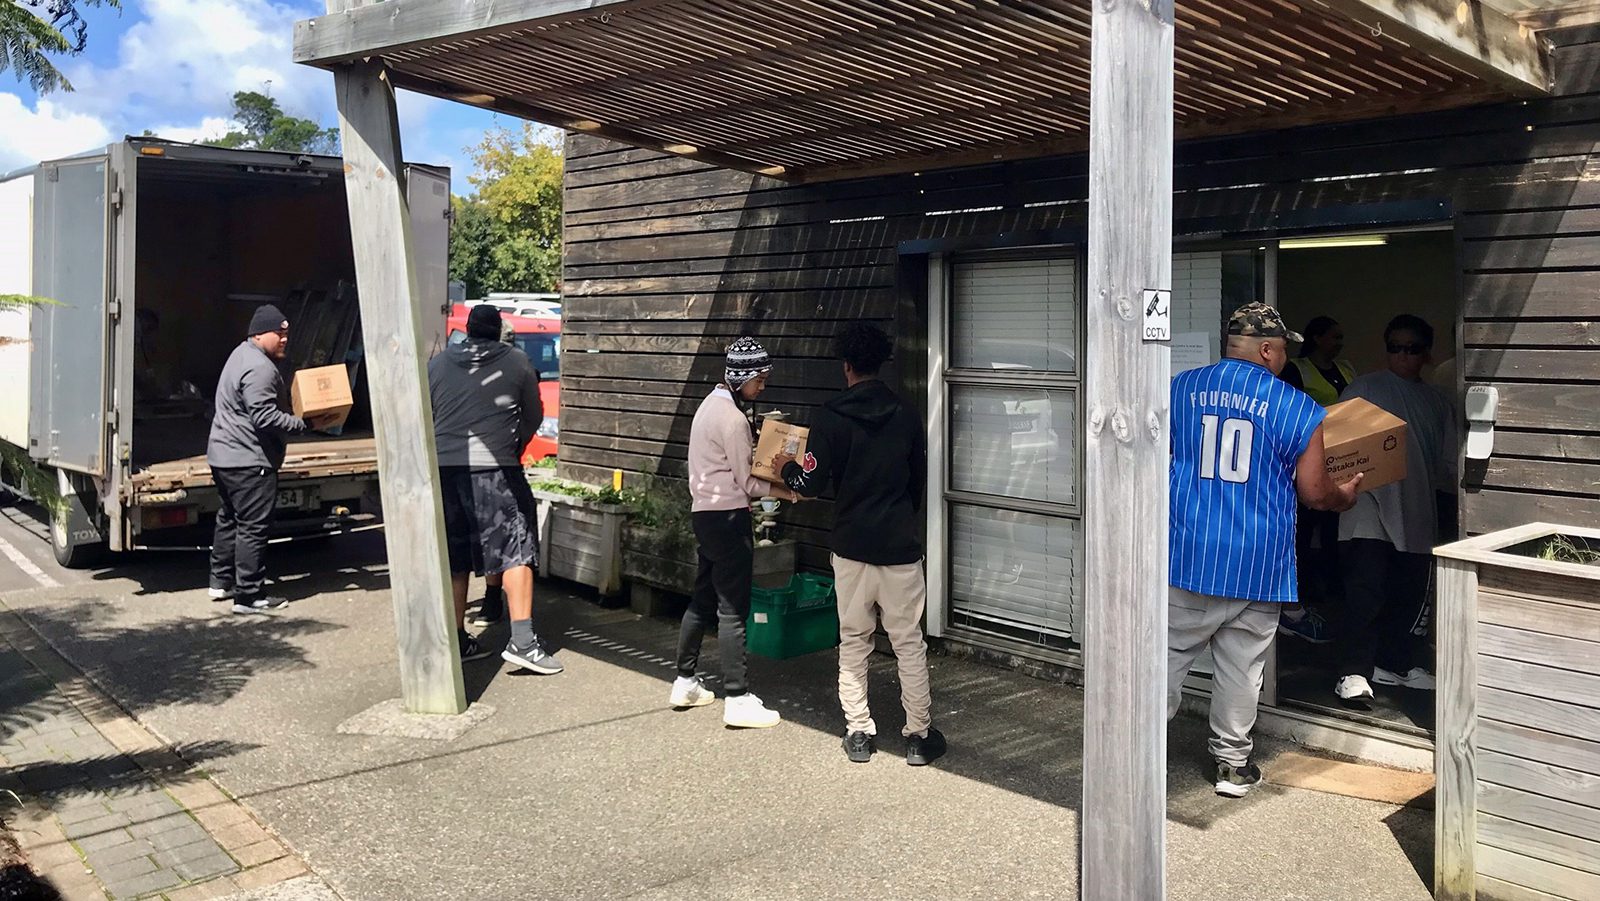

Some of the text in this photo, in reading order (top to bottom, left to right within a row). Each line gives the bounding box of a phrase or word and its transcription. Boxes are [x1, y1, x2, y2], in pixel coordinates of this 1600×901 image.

[1146, 326, 1167, 338] CCTV
[1190, 390, 1269, 418] FOURNIER
[1200, 413, 1255, 485] 10
[72, 529, 101, 541] TOY
